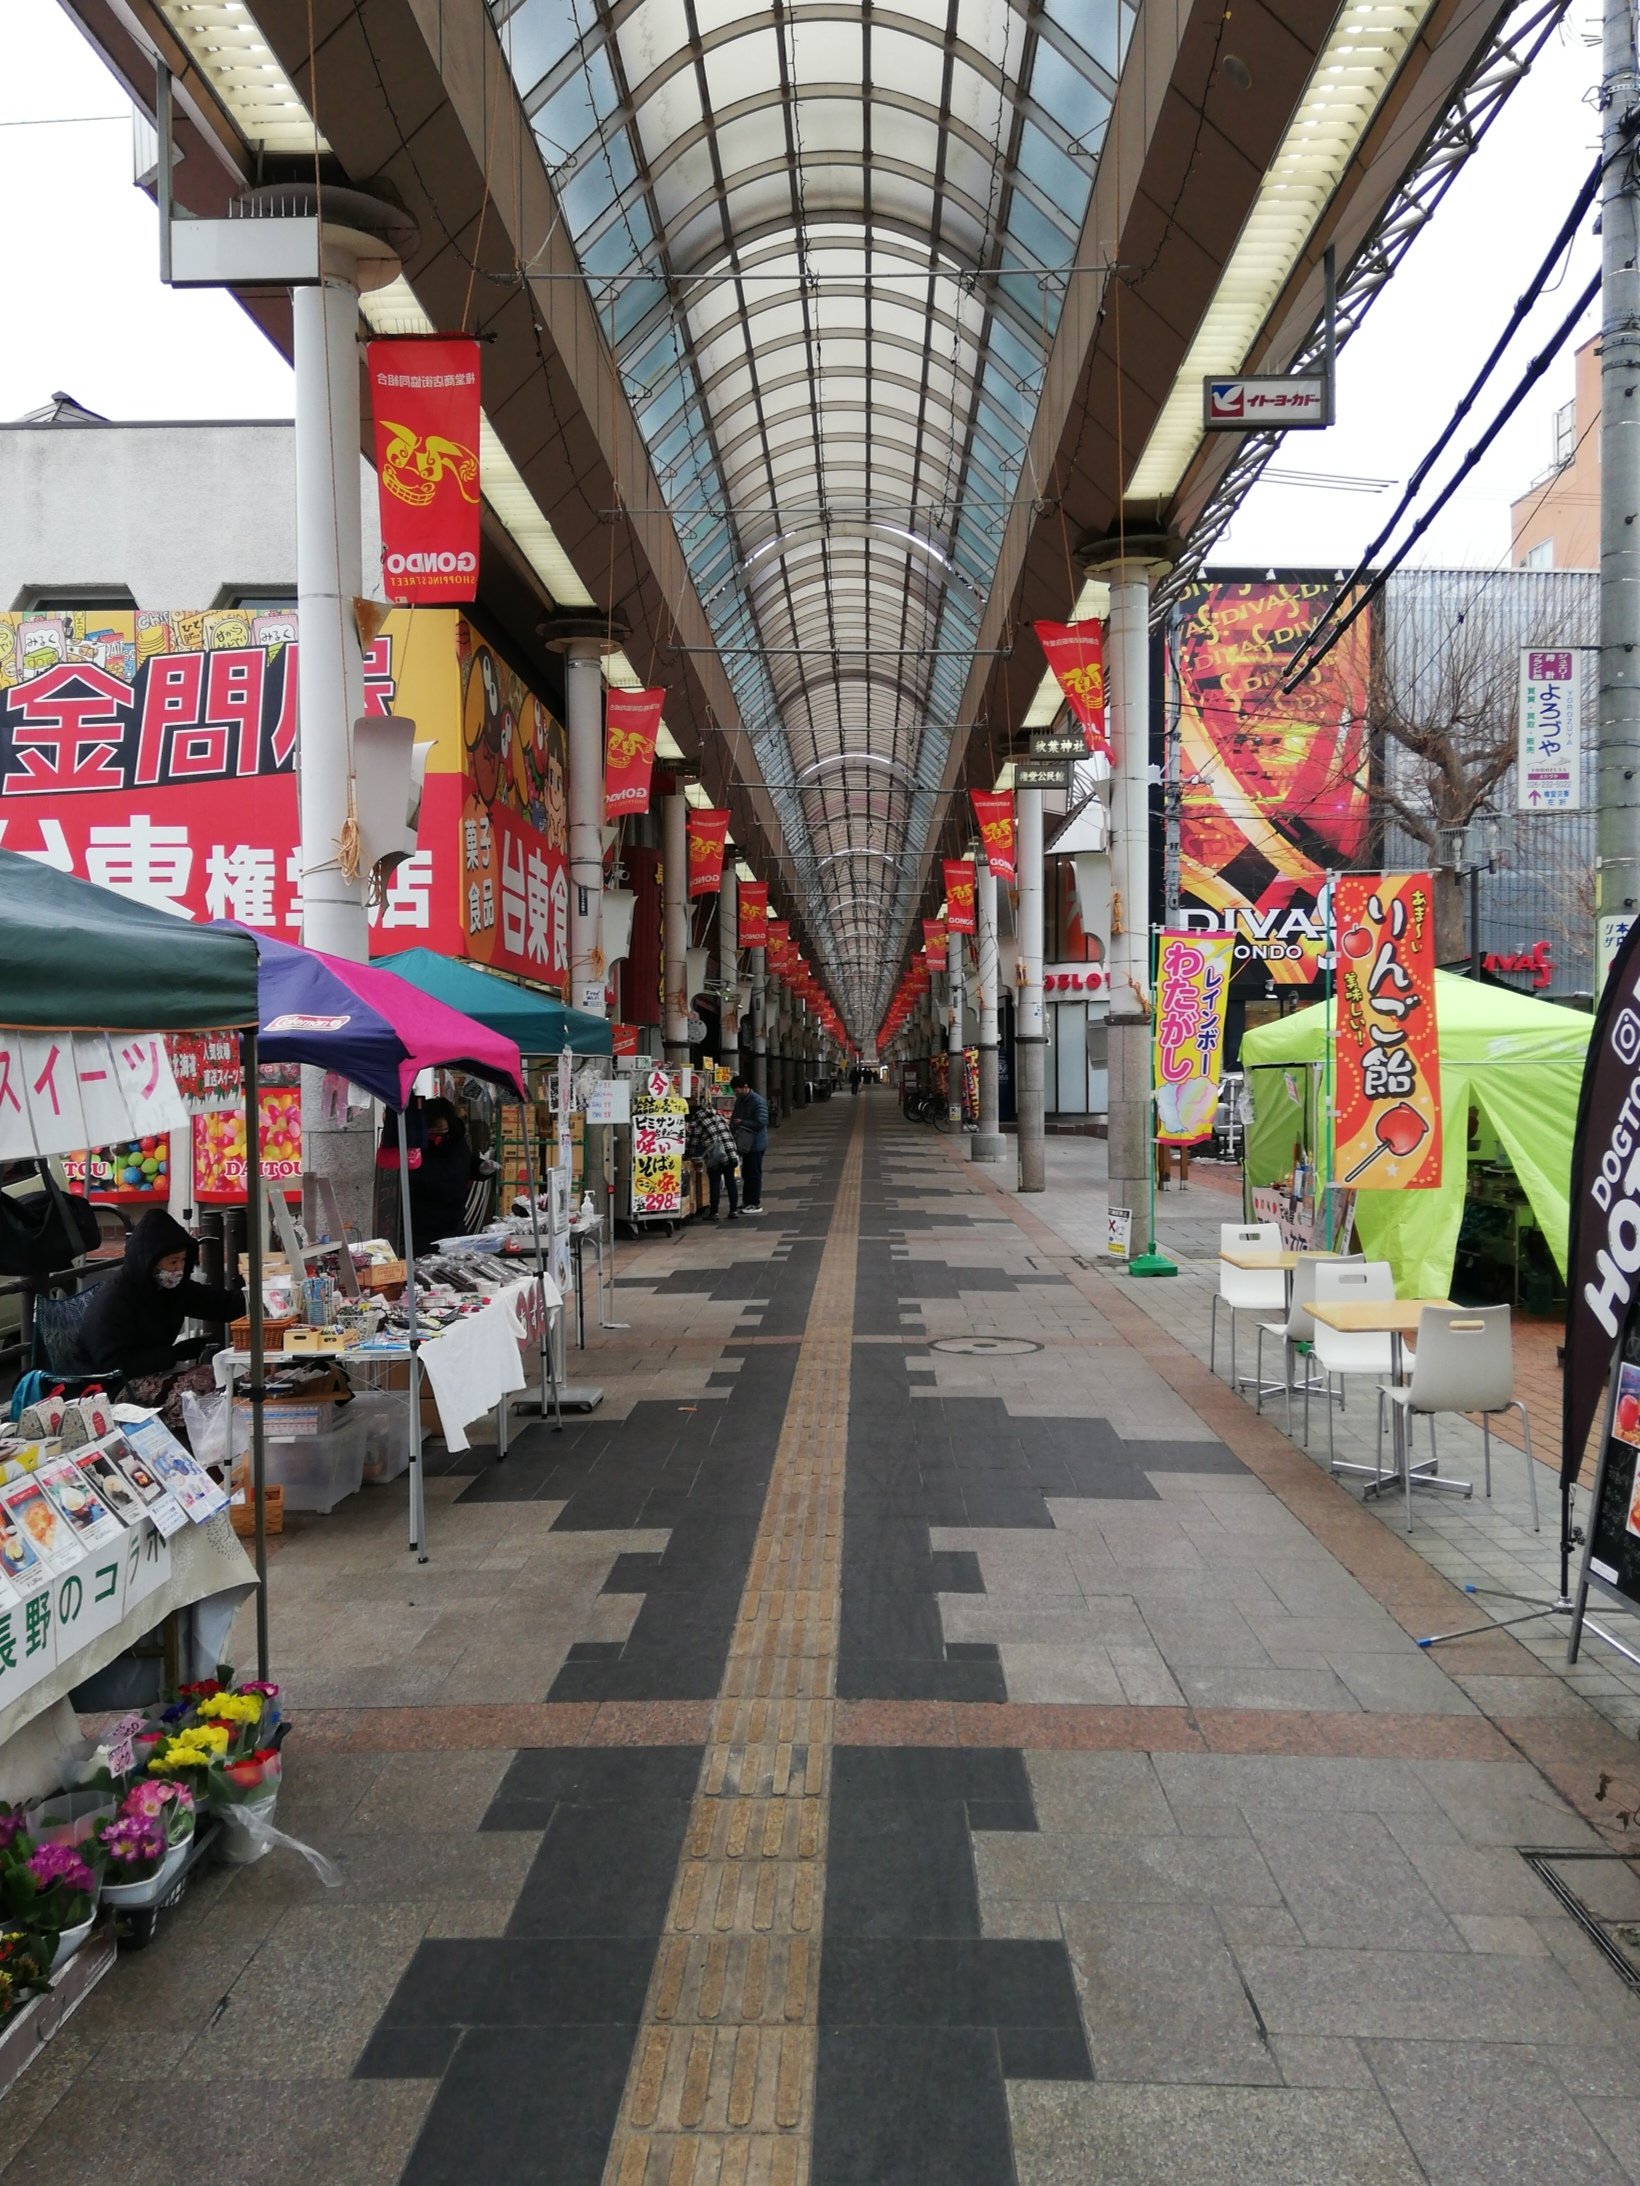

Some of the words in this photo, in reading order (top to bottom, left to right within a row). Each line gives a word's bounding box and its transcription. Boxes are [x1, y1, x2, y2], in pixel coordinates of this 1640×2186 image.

[1247, 394, 1320, 407] イトーヨーカドー
[27, 633, 56, 646] みるく
[261, 628, 291, 642] みるく
[1538, 683, 1562, 758] よろづや
[1034, 740, 1085, 753] 秋葉神社
[464, 817, 492, 871] 菓子
[468, 878, 495, 936] 食品
[1161, 942, 1205, 1082] わたがし
[1361, 895, 1420, 1098] りんご飴
[275, 1016, 329, 1028] Coleman
[1197, 967, 1222, 1076] レインボー
[650, 1072, 668, 1096] 今
